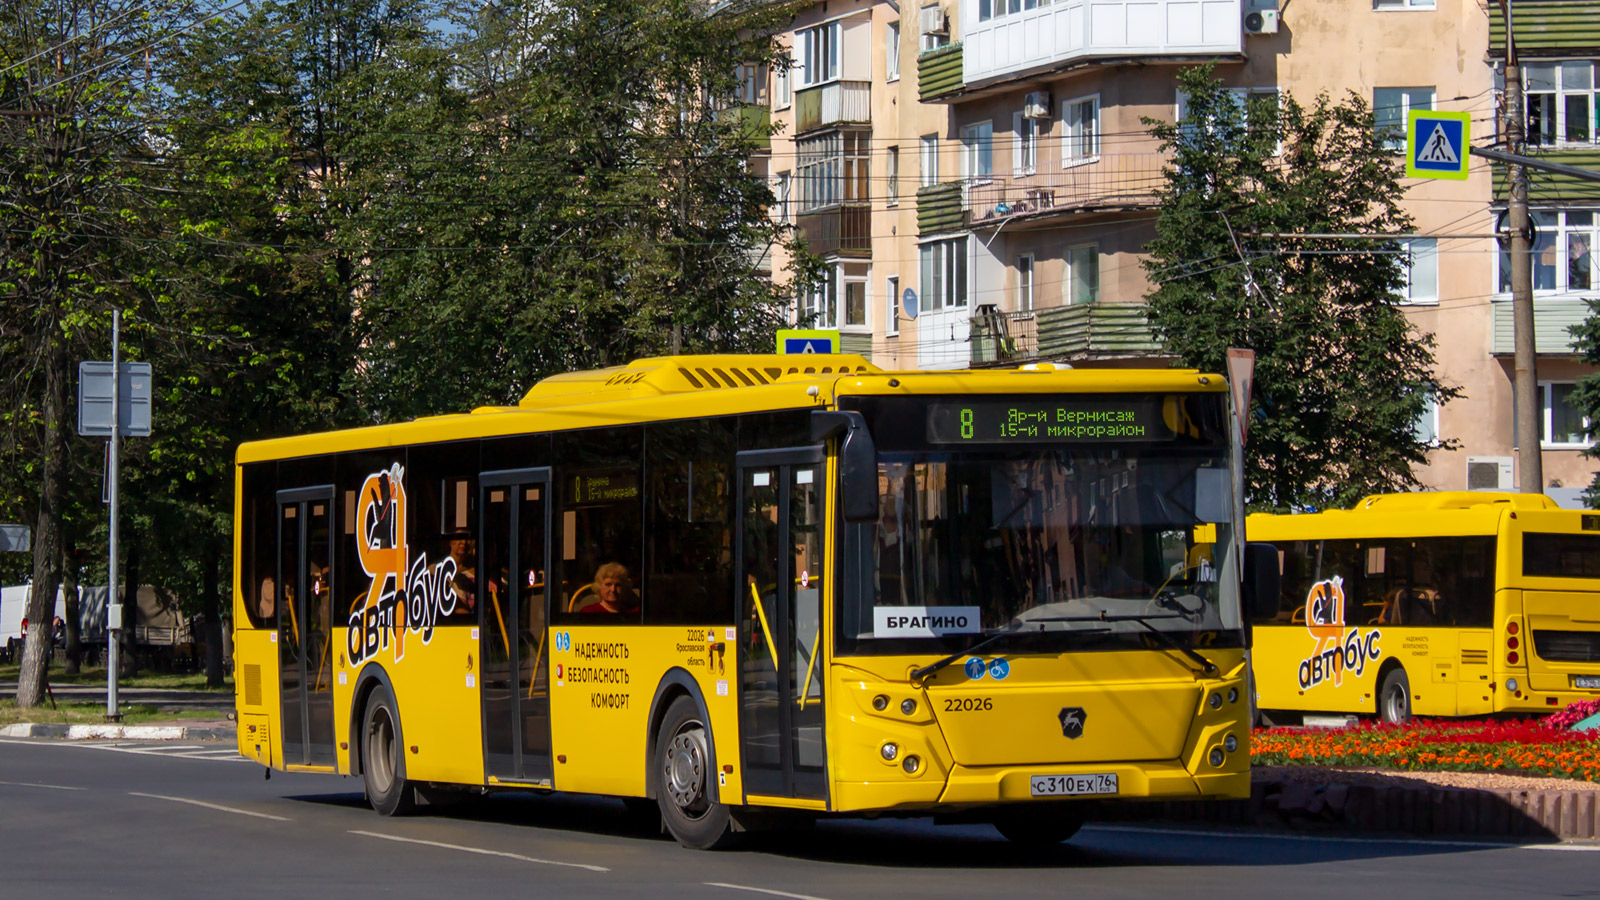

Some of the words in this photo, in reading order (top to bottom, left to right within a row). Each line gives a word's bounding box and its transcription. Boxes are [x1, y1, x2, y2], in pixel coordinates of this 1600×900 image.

[960, 408, 974, 439] 8
[1008, 408, 1047, 424] Яр-й
[1056, 408, 1135, 424] Вернисаж
[1000, 423, 1038, 437] 15-й
[1047, 424, 1145, 438] микрорайон
[575, 476, 581, 503] 8
[347, 552, 457, 667] автобус
[886, 616, 968, 629] БРАГИНО
[687, 629, 705, 642] 22026
[574, 642, 630, 660] НАДЕЖНОСТЬ
[676, 643, 705, 654] Ярославская
[687, 657, 706, 666] область
[568, 667, 630, 684] БЕЗОПАСНОСТЬ
[590, 693, 630, 709] КОМФОРТ
[944, 697, 993, 712] 22026
